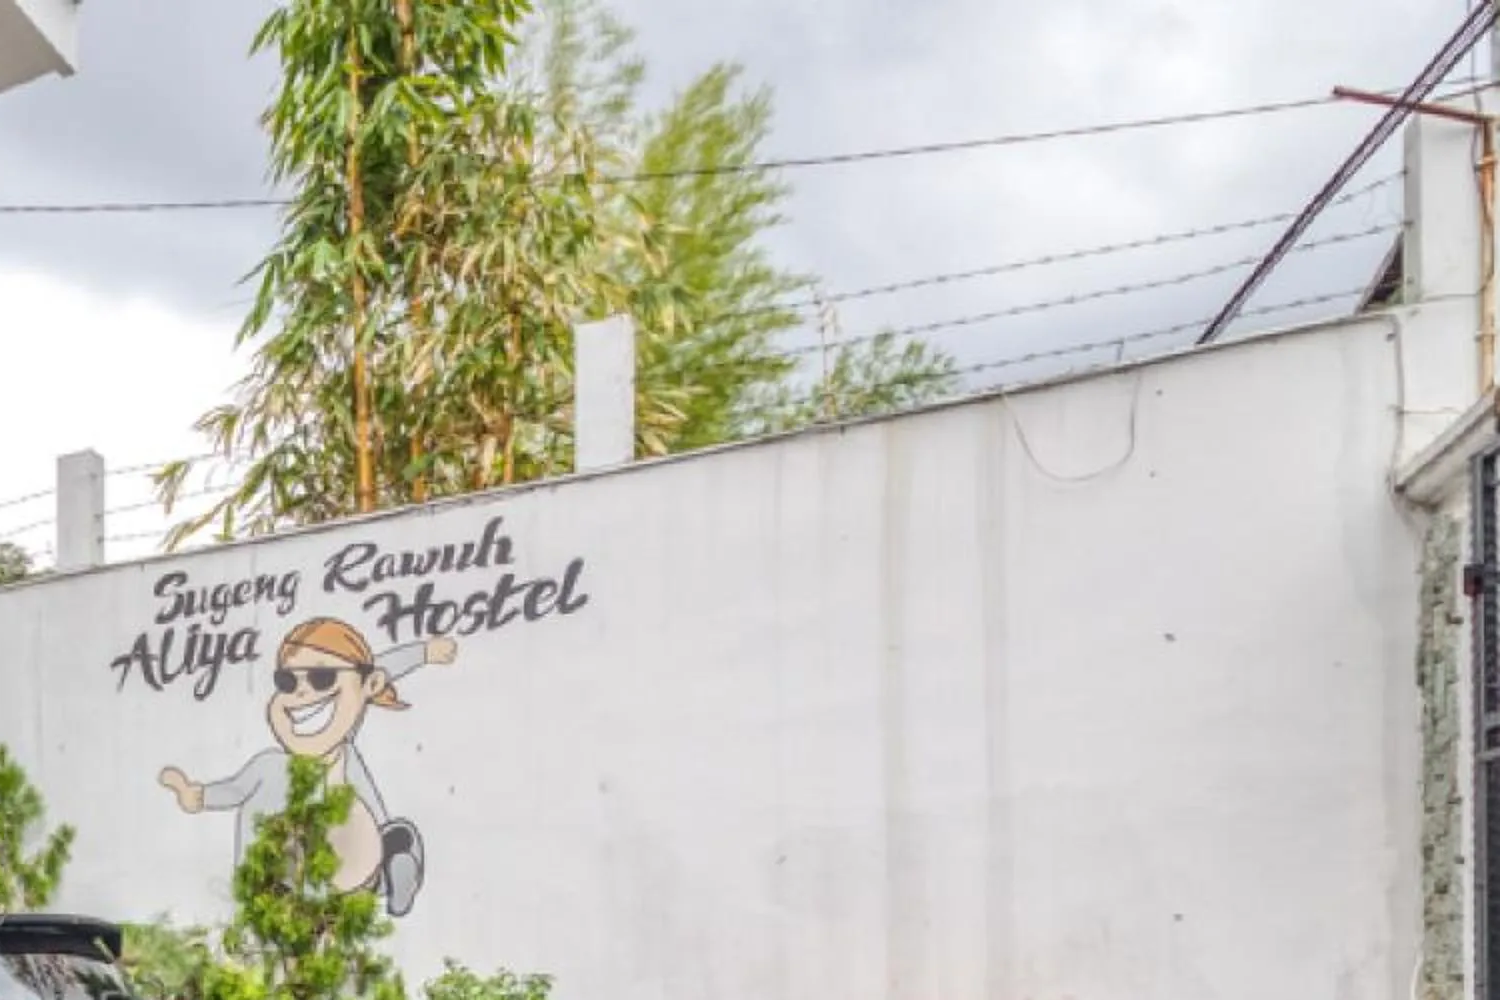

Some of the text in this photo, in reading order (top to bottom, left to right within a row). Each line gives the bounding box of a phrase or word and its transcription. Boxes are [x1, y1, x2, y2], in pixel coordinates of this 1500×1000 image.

[153, 516, 514, 625] Sugeng Rawuh
[363, 557, 593, 642] Hostel
